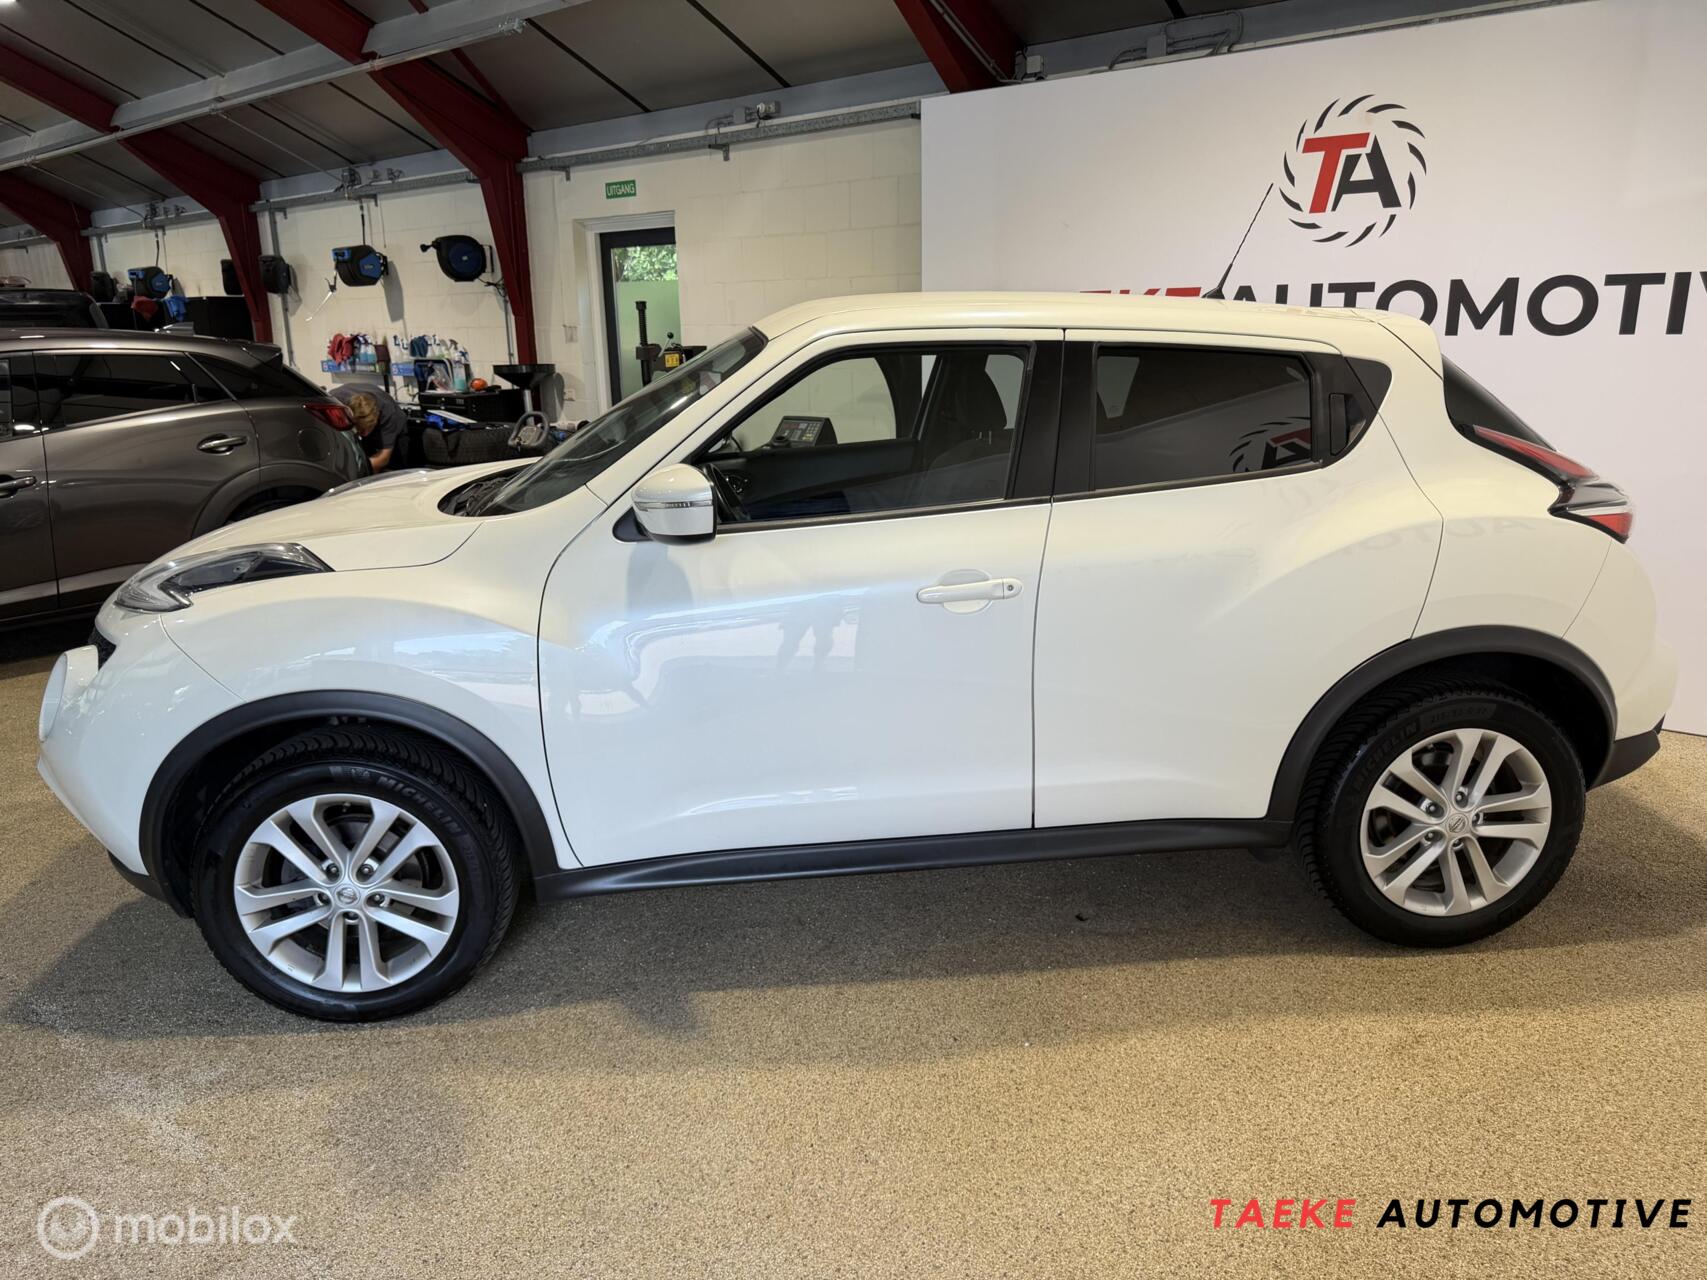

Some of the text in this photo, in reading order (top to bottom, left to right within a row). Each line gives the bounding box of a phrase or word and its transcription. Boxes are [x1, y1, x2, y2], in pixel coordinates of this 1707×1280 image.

[606, 183, 635, 196] UITGANG
[1302, 131, 1402, 214] TA
[375, 775, 462, 834] MICHELIN
